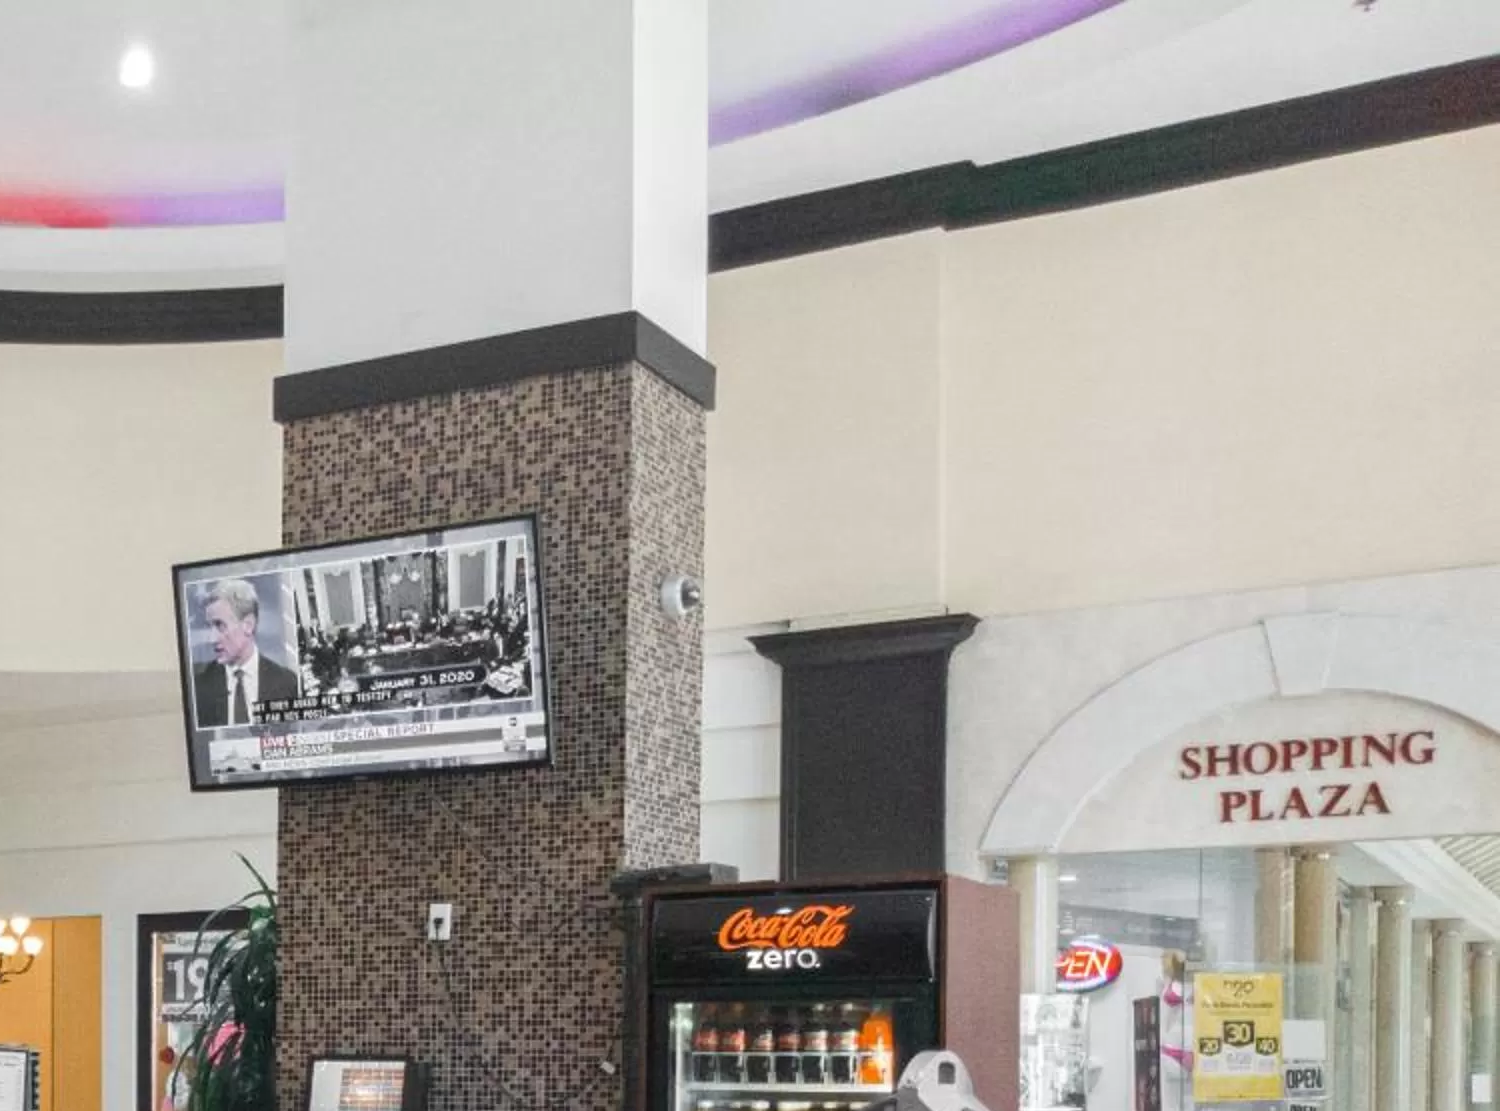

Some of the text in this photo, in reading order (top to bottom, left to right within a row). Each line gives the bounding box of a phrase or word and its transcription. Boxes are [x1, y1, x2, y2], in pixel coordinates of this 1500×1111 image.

[370, 676, 415, 691] JANUARY
[439, 670, 475, 685] 2020
[333, 728, 383, 742] SPECIAL
[387, 723, 434, 736] REPORT
[1179, 731, 1436, 780] SHOPPING
[1219, 781, 1391, 823] PLAZA
[718, 904, 856, 950] Coca-Cola
[1055, 951, 1113, 978] EN
[1225, 1023, 1251, 1043] 30
[1286, 1065, 1322, 1089] OPEN
